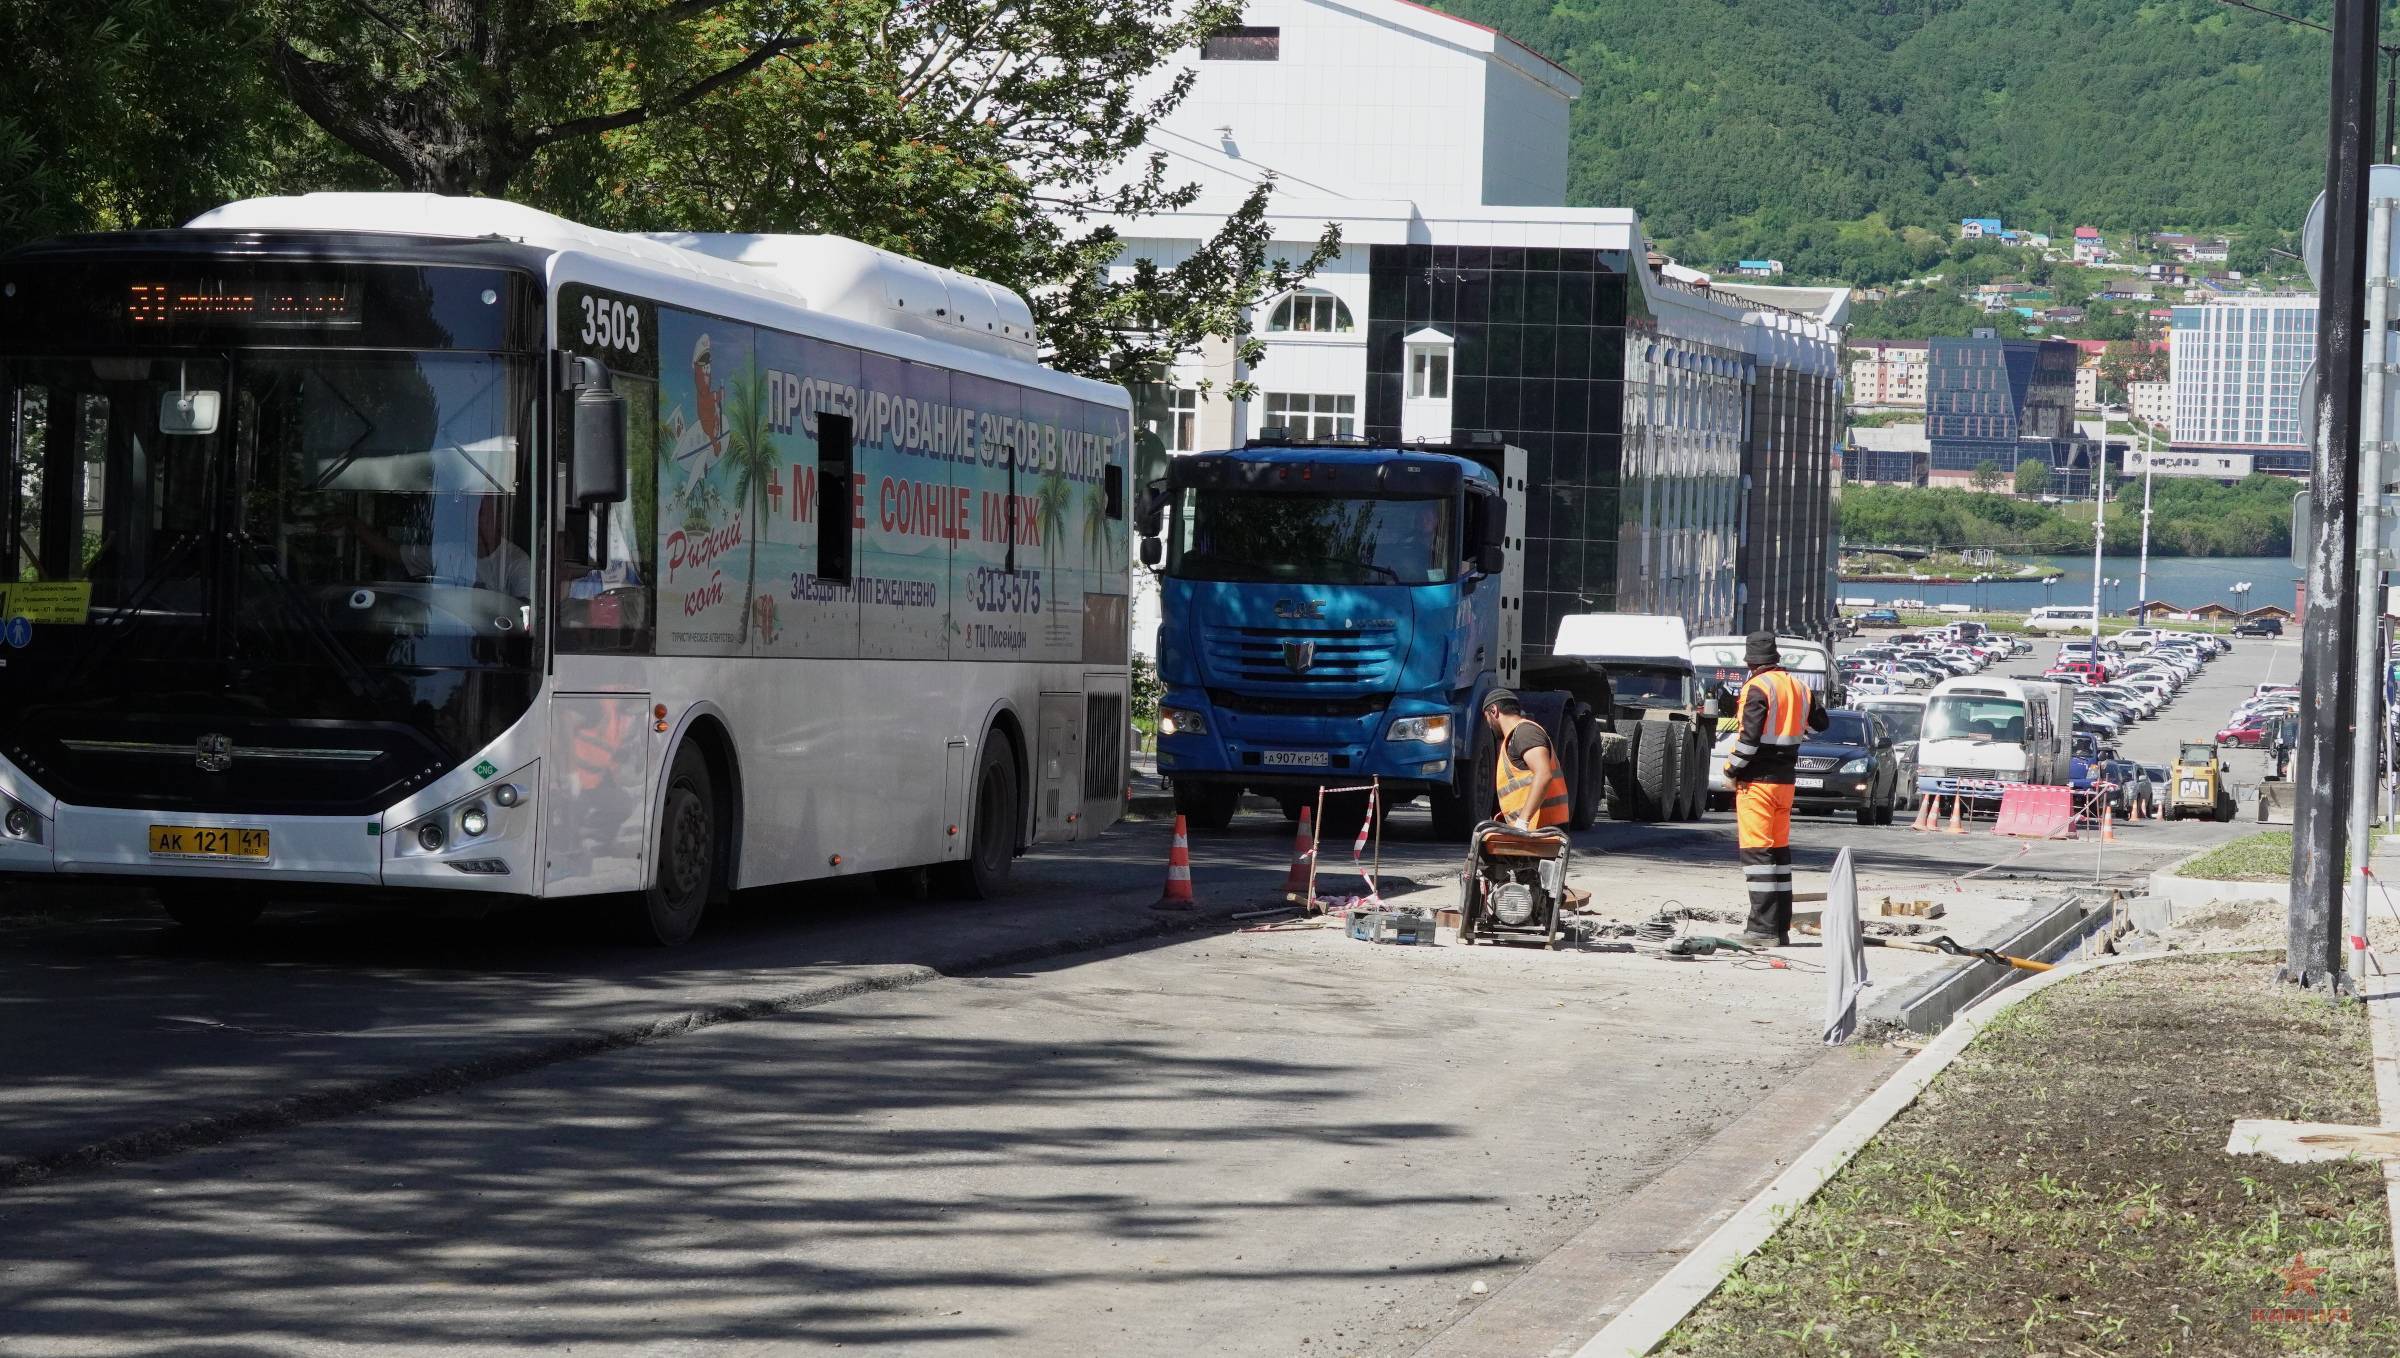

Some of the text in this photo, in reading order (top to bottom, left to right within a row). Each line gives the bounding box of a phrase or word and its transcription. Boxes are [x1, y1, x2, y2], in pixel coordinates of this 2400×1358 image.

[581, 295, 639, 353] 3503
[980, 412, 1041, 470] ЗУБОВ
[1044, 424, 1057, 472] В
[792, 464, 866, 529] МЕ
[880, 476, 970, 549] СОЛНЦЕ
[982, 491, 1041, 546] ПЛЯЖ
[666, 513, 742, 584] Рыжий
[684, 570, 723, 617] кот
[875, 578, 936, 611] ЕЖЕДНЕВНО
[976, 566, 1040, 614] 313-575
[975, 624, 986, 653] ТЦ
[987, 624, 1027, 653] Посейдон
[477, 765, 493, 775] CNG
[2180, 780, 2209, 798] CAT
[160, 831, 261, 852] АК 121 41
[244, 847, 259, 855] RUS
